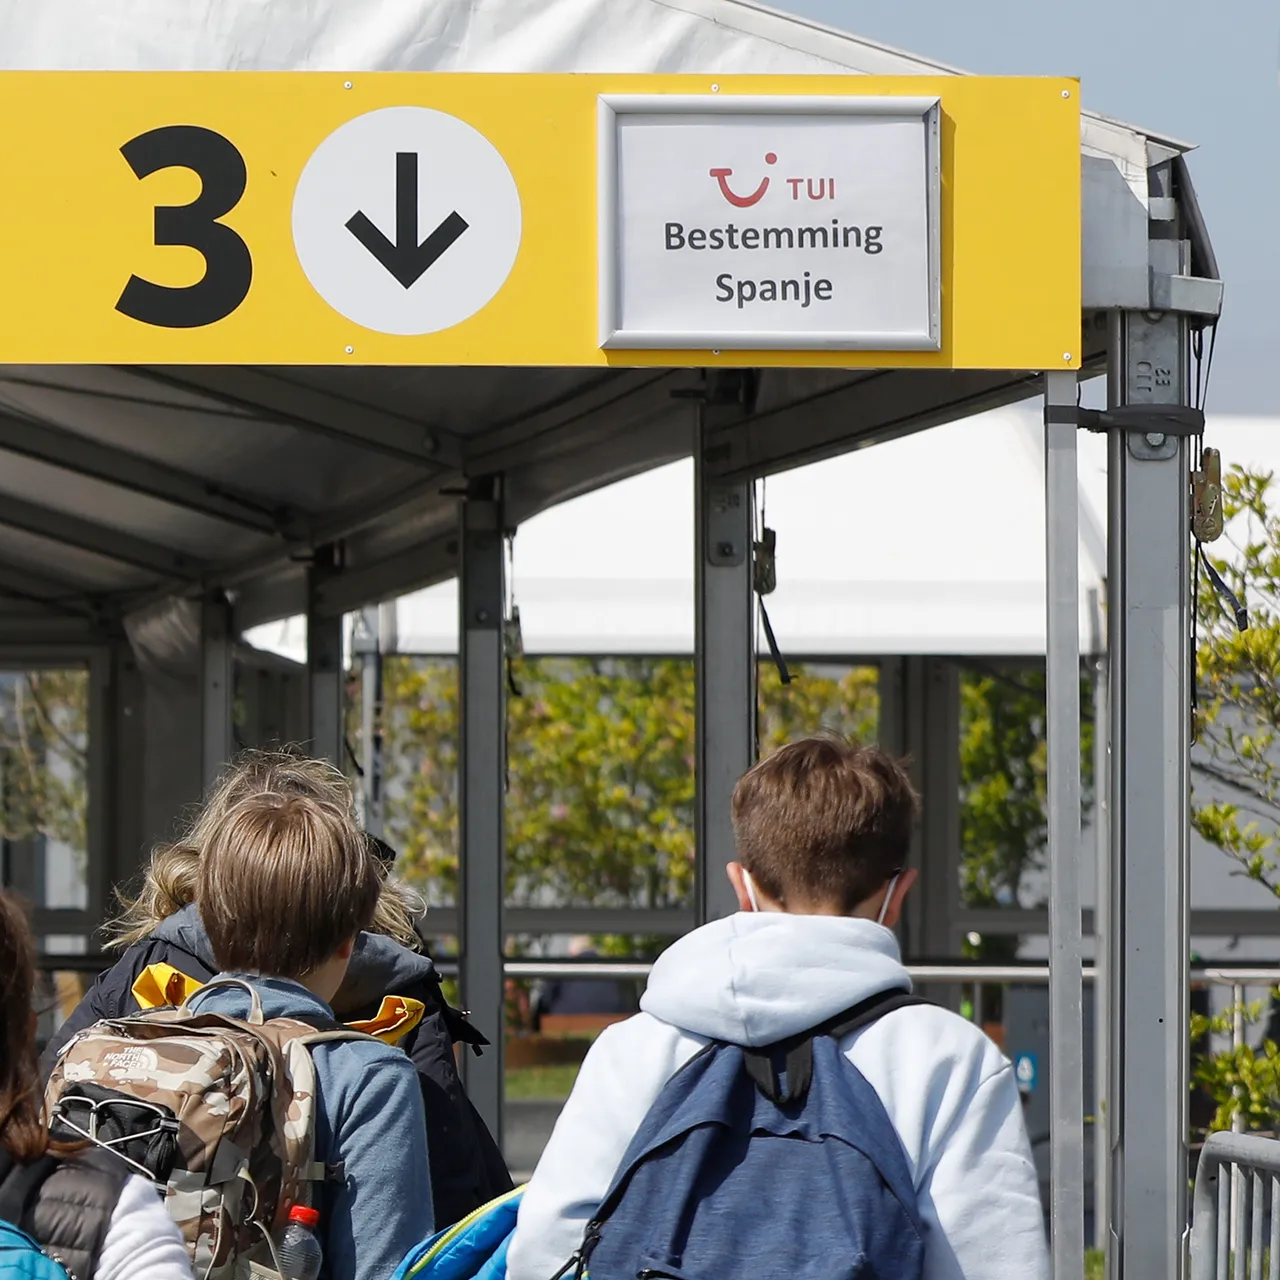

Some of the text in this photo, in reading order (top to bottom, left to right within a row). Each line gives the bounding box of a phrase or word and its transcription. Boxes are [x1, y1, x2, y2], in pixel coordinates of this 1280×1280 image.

[786, 177, 836, 201] TUI
[113, 124, 254, 329] 3
[663, 218, 883, 255] Bestemming
[715, 271, 834, 309] Spanje
[104, 1052, 140, 1061] NORTH
[123, 1046, 144, 1054] THE
[109, 1059, 137, 1069] FACE
